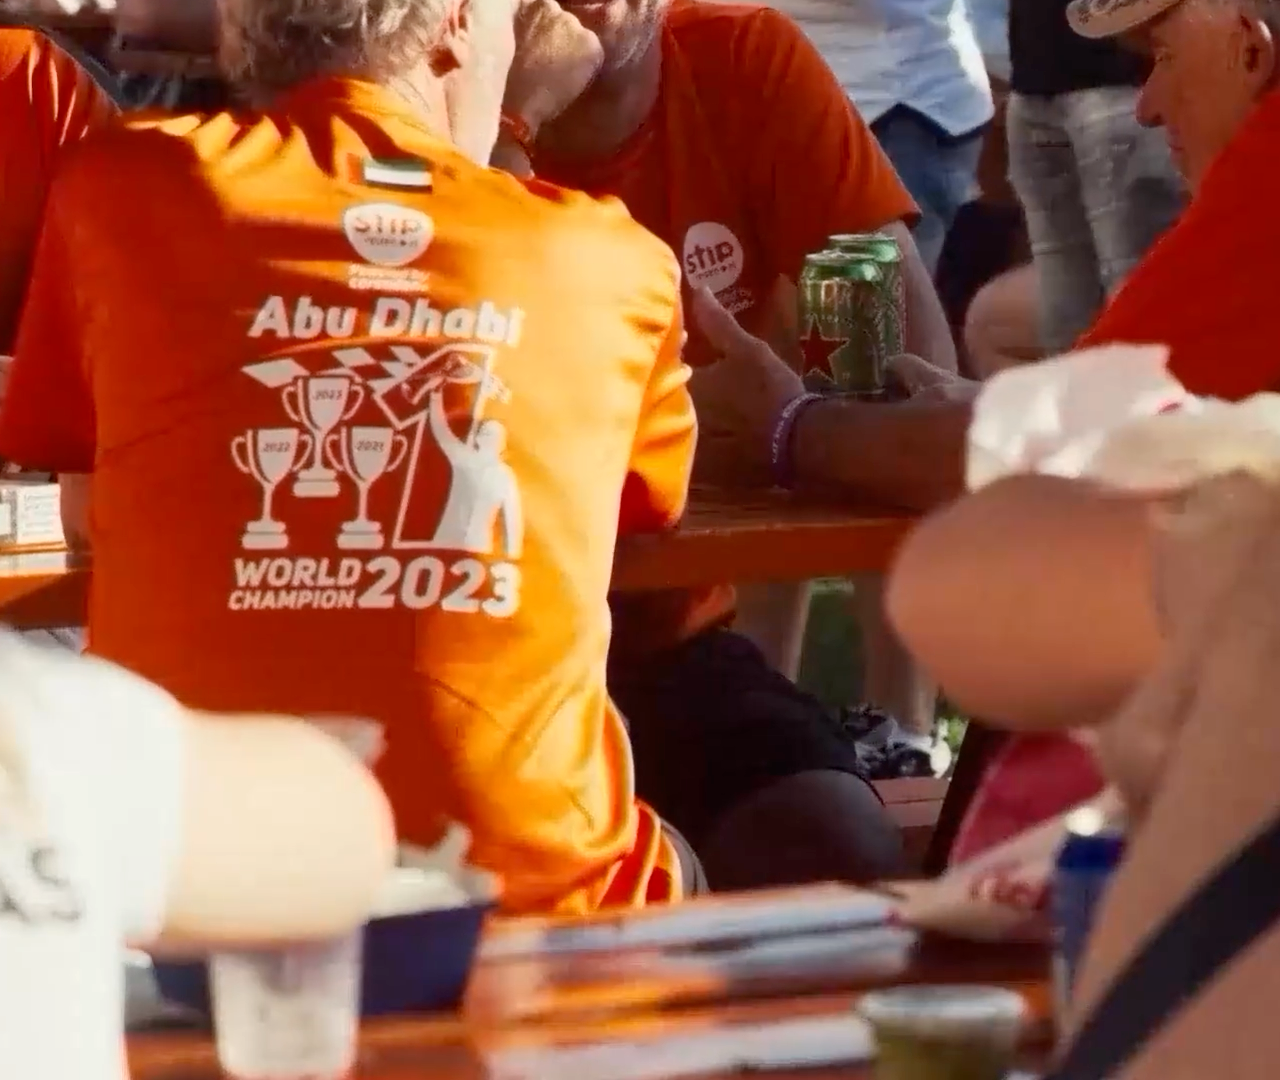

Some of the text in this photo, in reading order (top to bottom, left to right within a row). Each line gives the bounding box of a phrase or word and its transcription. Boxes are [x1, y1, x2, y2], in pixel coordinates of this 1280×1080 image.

[686, 241, 734, 274] stip
[246, 295, 526, 349] Abu Dhabi
[227, 588, 357, 611] CHAMPION
[234, 555, 521, 619] WORLD 2023
